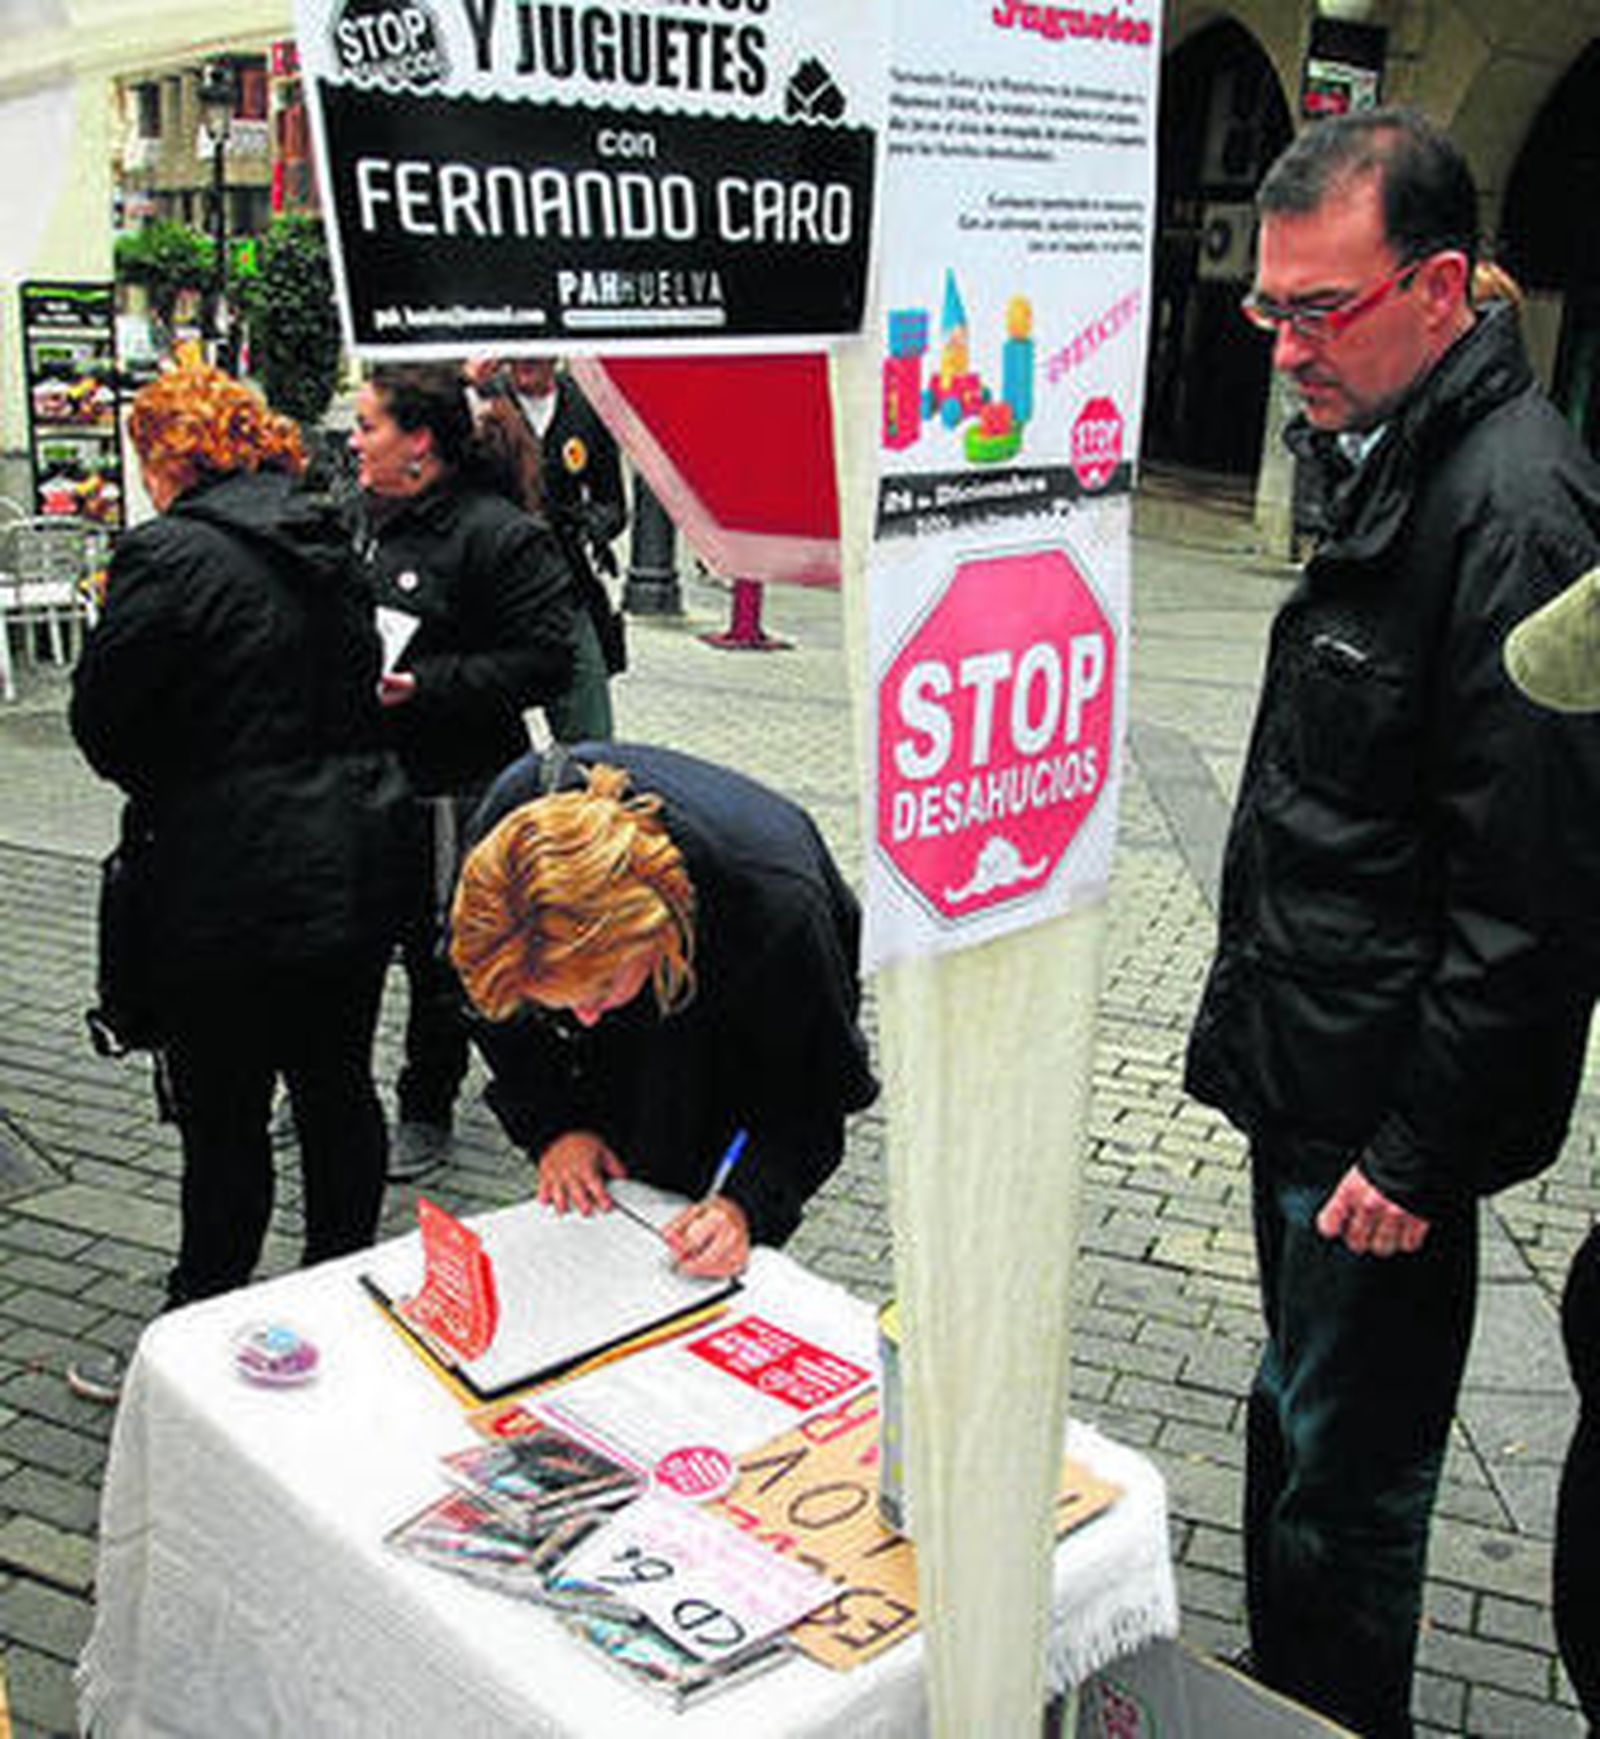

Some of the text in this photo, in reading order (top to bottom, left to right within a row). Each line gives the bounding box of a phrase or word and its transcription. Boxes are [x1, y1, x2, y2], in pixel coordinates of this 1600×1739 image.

[338, 9, 426, 63] STOP
[462, 0, 768, 97] Y JUGUETES
[597, 129, 656, 159] con
[355, 159, 852, 245] FERNANDO CARO
[894, 634, 1107, 780] STOP
[892, 747, 1098, 842] DESAHUCIOS
